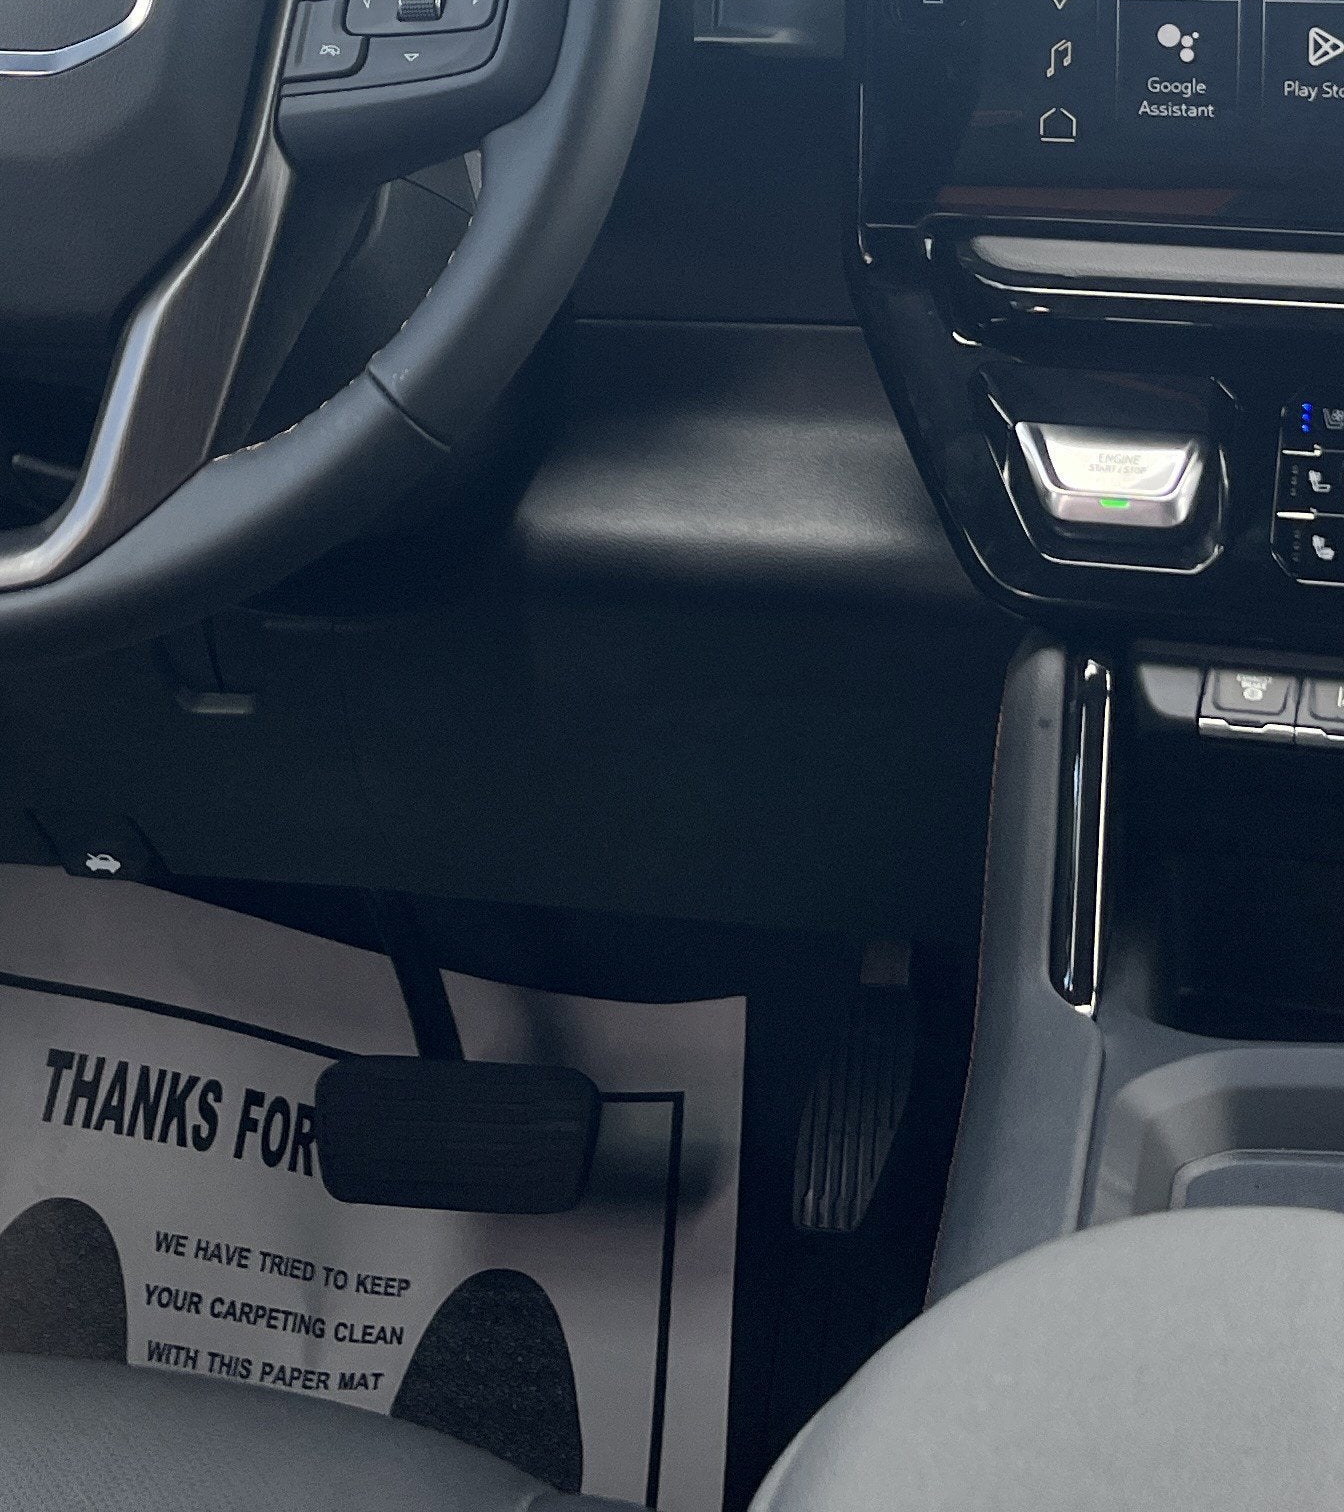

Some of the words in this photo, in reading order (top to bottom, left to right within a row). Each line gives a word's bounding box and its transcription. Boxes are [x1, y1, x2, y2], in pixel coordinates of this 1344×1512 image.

[1146, 78, 1207, 98] Google
[1283, 81, 1318, 102] Play
[1138, 100, 1215, 118] Assistant
[1098, 452, 1142, 467] ENGINE
[42, 1048, 223, 1152] THANKS
[233, 1088, 316, 1177] FOR
[156, 1231, 188, 1256] WE
[194, 1238, 251, 1269] HAVE
[259, 1251, 315, 1281] TRIED
[322, 1265, 348, 1290] TO
[355, 1274, 411, 1297] KEEP
[145, 1283, 203, 1314] YOUR
[210, 1297, 326, 1338] CARPETING
[334, 1322, 404, 1345] CLEAN
[147, 1340, 199, 1369] WITH
[208, 1352, 253, 1379] THIS
[259, 1362, 330, 1390] PAPER
[338, 1372, 384, 1390] MAT
